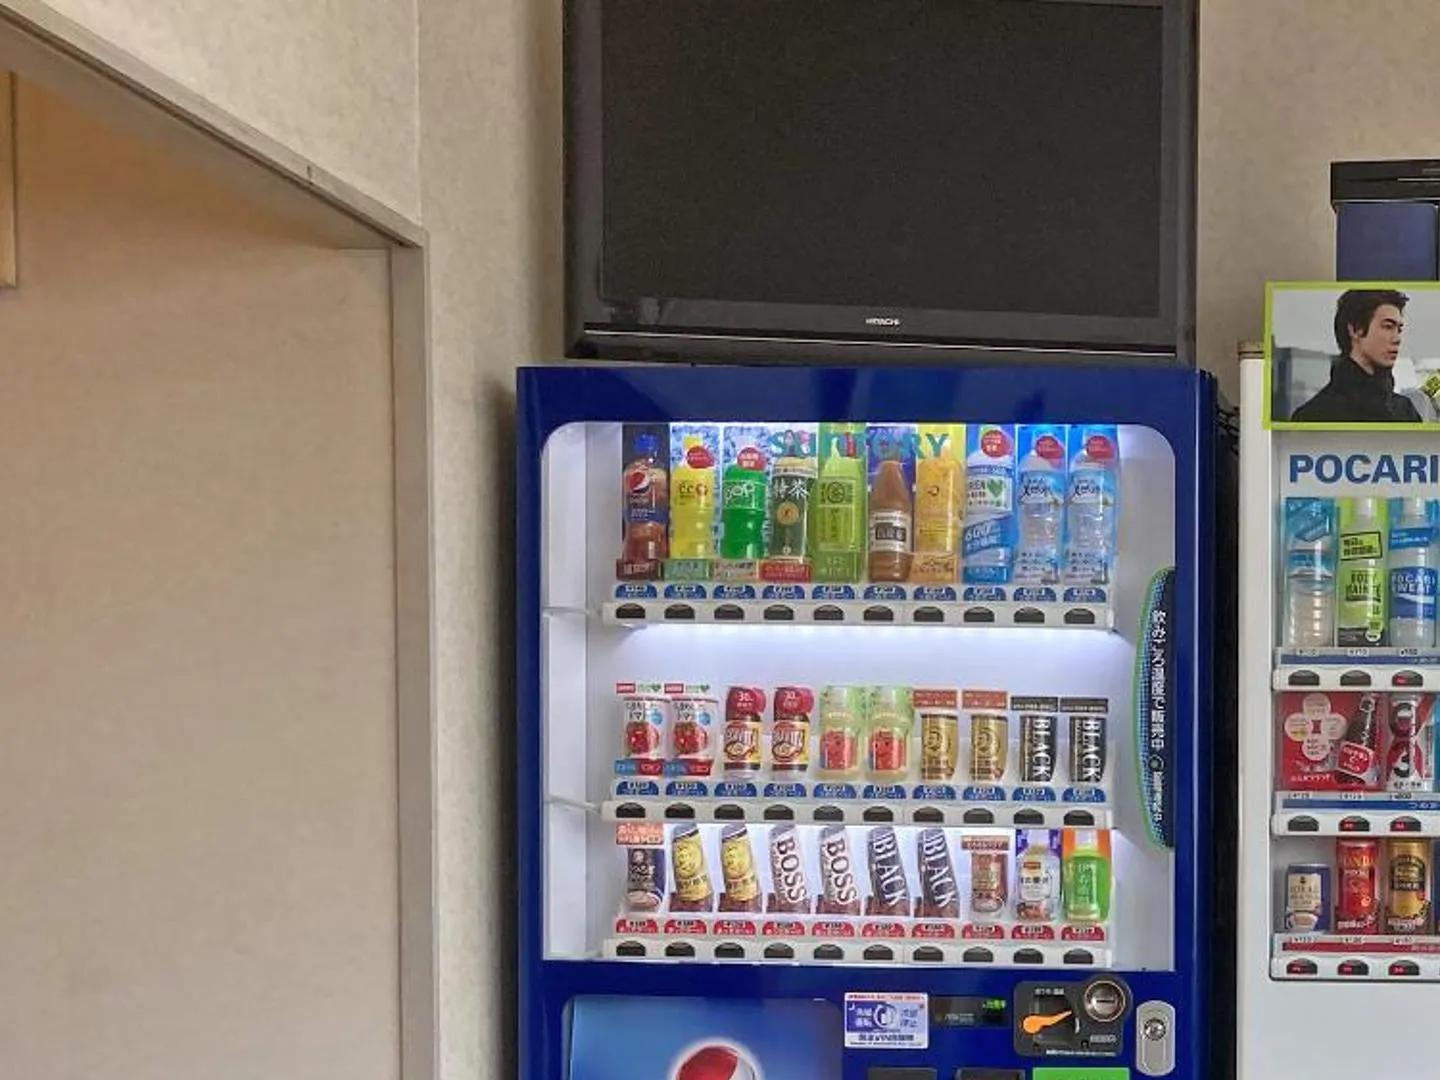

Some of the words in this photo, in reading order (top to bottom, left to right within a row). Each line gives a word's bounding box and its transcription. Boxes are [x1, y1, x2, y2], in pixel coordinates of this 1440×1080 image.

[1289, 454, 1438, 484] POCARI
[1032, 717, 1051, 782] BLACK
[1081, 717, 1102, 784] BLACK
[776, 836, 808, 904] BOSS
[826, 837, 858, 905] BOSS
[871, 831, 907, 908] BLACK
[922, 831, 957, 908] BLACK
